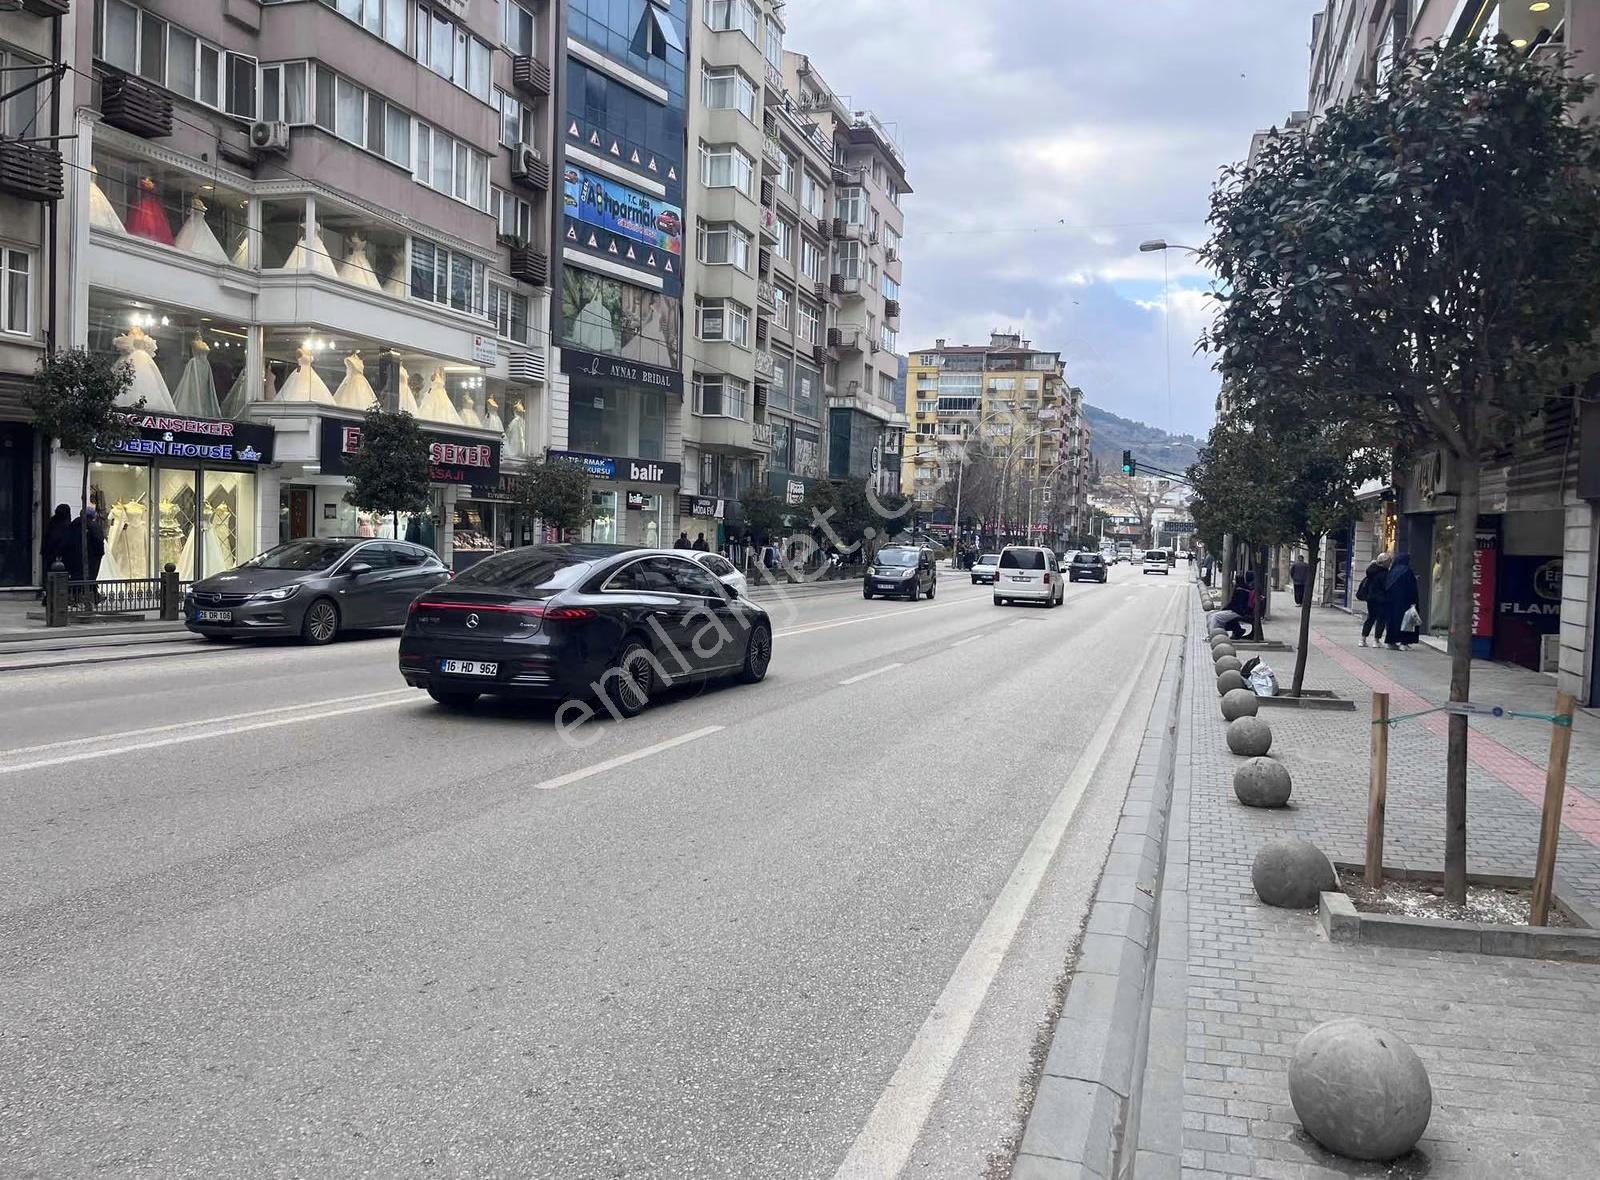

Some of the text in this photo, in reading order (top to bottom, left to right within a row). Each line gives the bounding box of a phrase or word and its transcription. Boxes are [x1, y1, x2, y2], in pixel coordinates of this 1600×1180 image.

[610, 365, 671, 387] AYNAZ BRIDAL
[169, 442, 232, 460] HOUSE
[630, 462, 664, 481] balir
[446, 660, 497, 675] 16 HD 962
